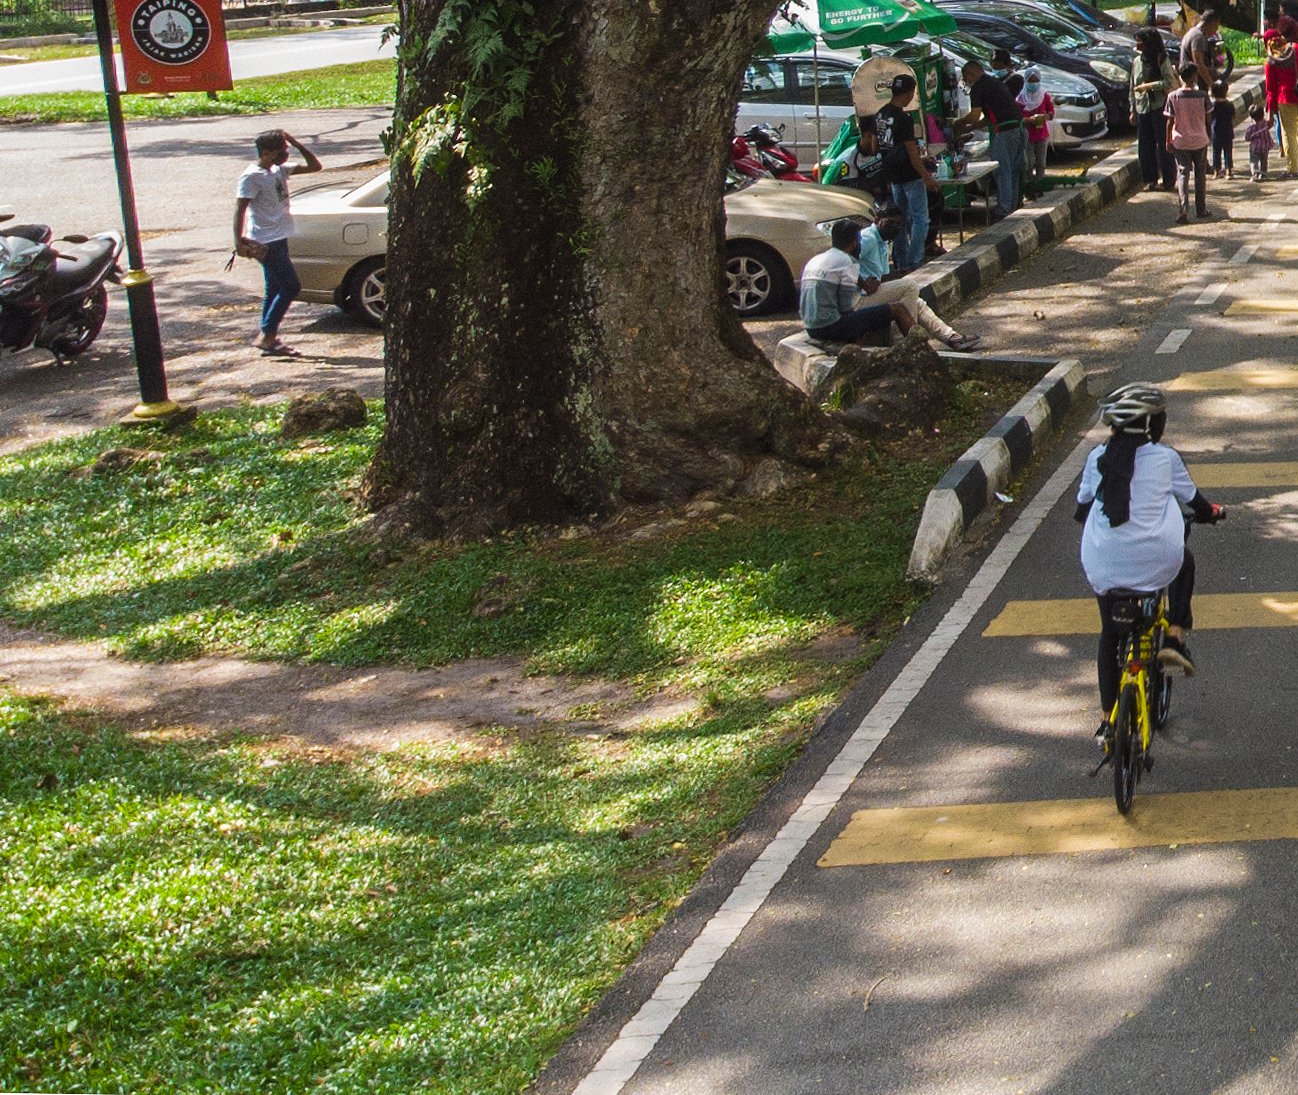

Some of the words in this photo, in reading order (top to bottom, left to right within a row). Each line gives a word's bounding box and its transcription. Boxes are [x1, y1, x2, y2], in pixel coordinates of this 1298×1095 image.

[141, 0, 196, 17] TAIPING
[826, 8, 863, 19] ENERGY
[830, 17, 844, 25] GO
[847, 9, 893, 23] FURTHER
